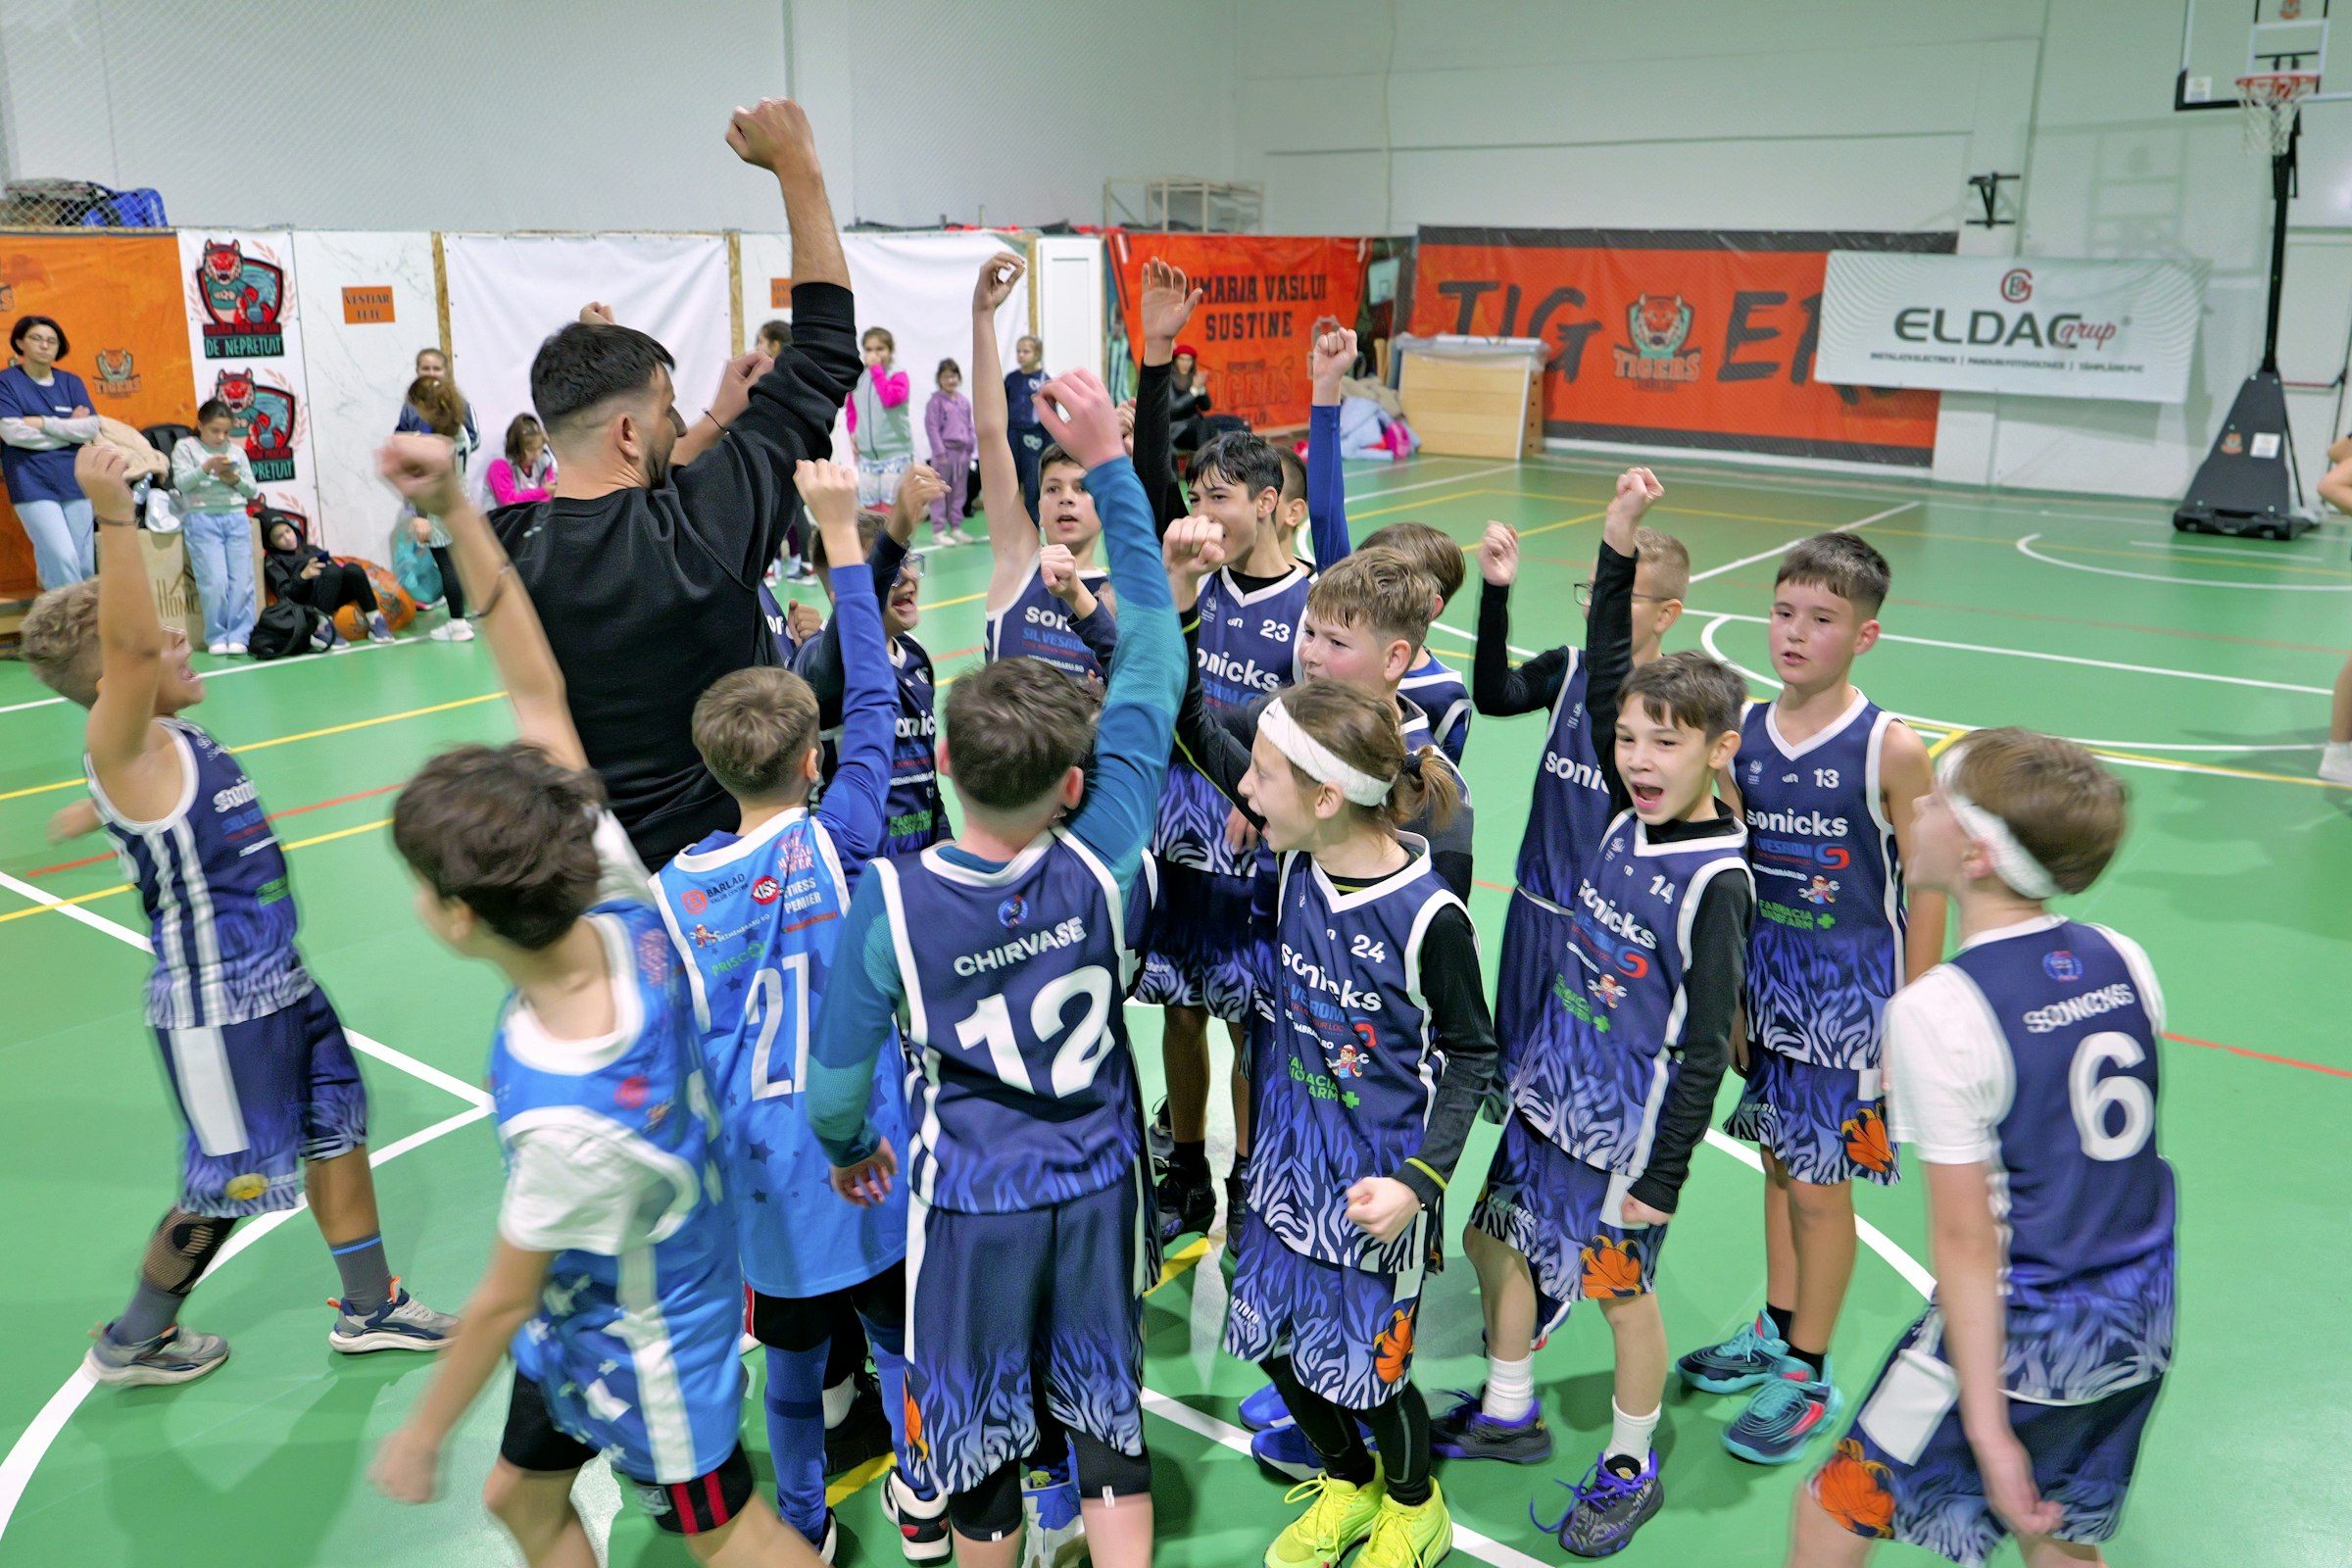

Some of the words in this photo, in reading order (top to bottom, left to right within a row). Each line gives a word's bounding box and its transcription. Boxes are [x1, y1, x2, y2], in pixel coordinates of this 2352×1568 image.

[1265, 274, 1327, 302] VASLUI
[1205, 311, 1293, 341] SUSTINE
[1894, 308, 2082, 349] ELDAC
[206, 338, 220, 357] DE
[1613, 349, 1701, 383] TIGERS
[1260, 618, 1291, 643] 23
[1814, 768, 1840, 789] 13
[1648, 874, 1676, 906] 14
[954, 915, 1088, 978] CHIRVASE
[1350, 934, 1386, 963] 24
[955, 964, 1116, 1100] 12
[2068, 1031, 2156, 1162] 6
